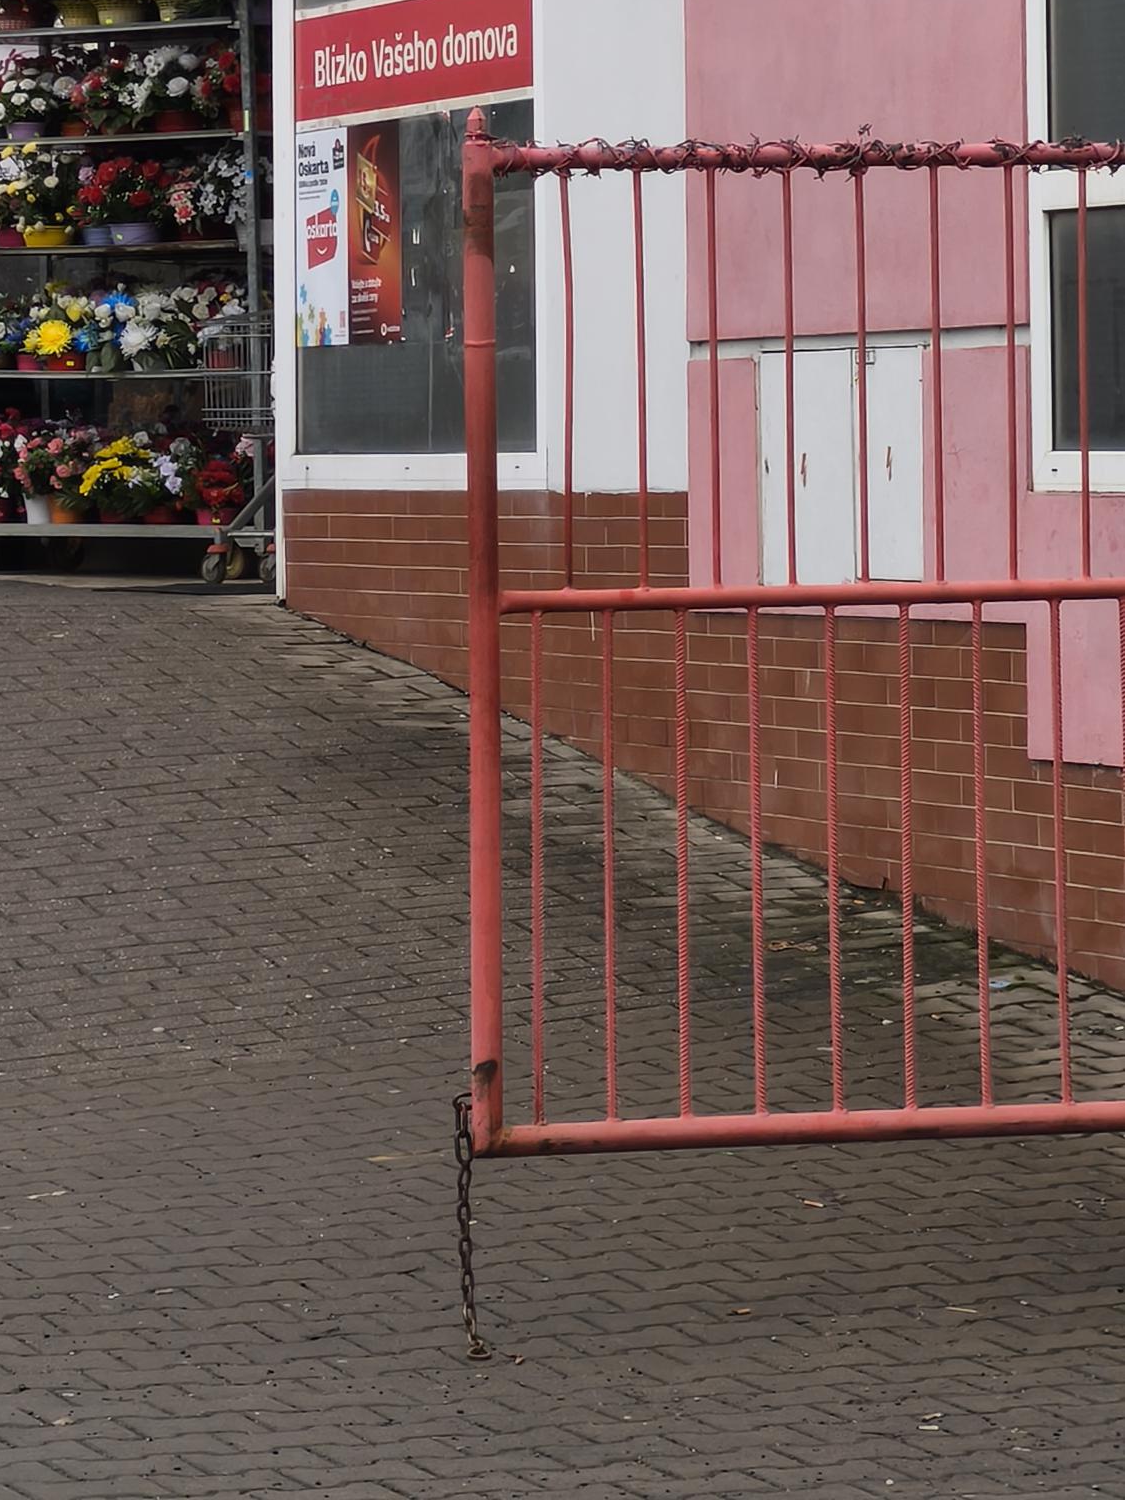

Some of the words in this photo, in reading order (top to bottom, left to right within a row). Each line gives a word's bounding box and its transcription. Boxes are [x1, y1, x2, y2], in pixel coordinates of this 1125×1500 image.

[314, 43, 367, 88] Blízko
[372, 32, 437, 78] Vašeho
[442, 23, 518, 67] domova
[298, 141, 316, 159] Nová
[298, 160, 329, 177] Oskarta
